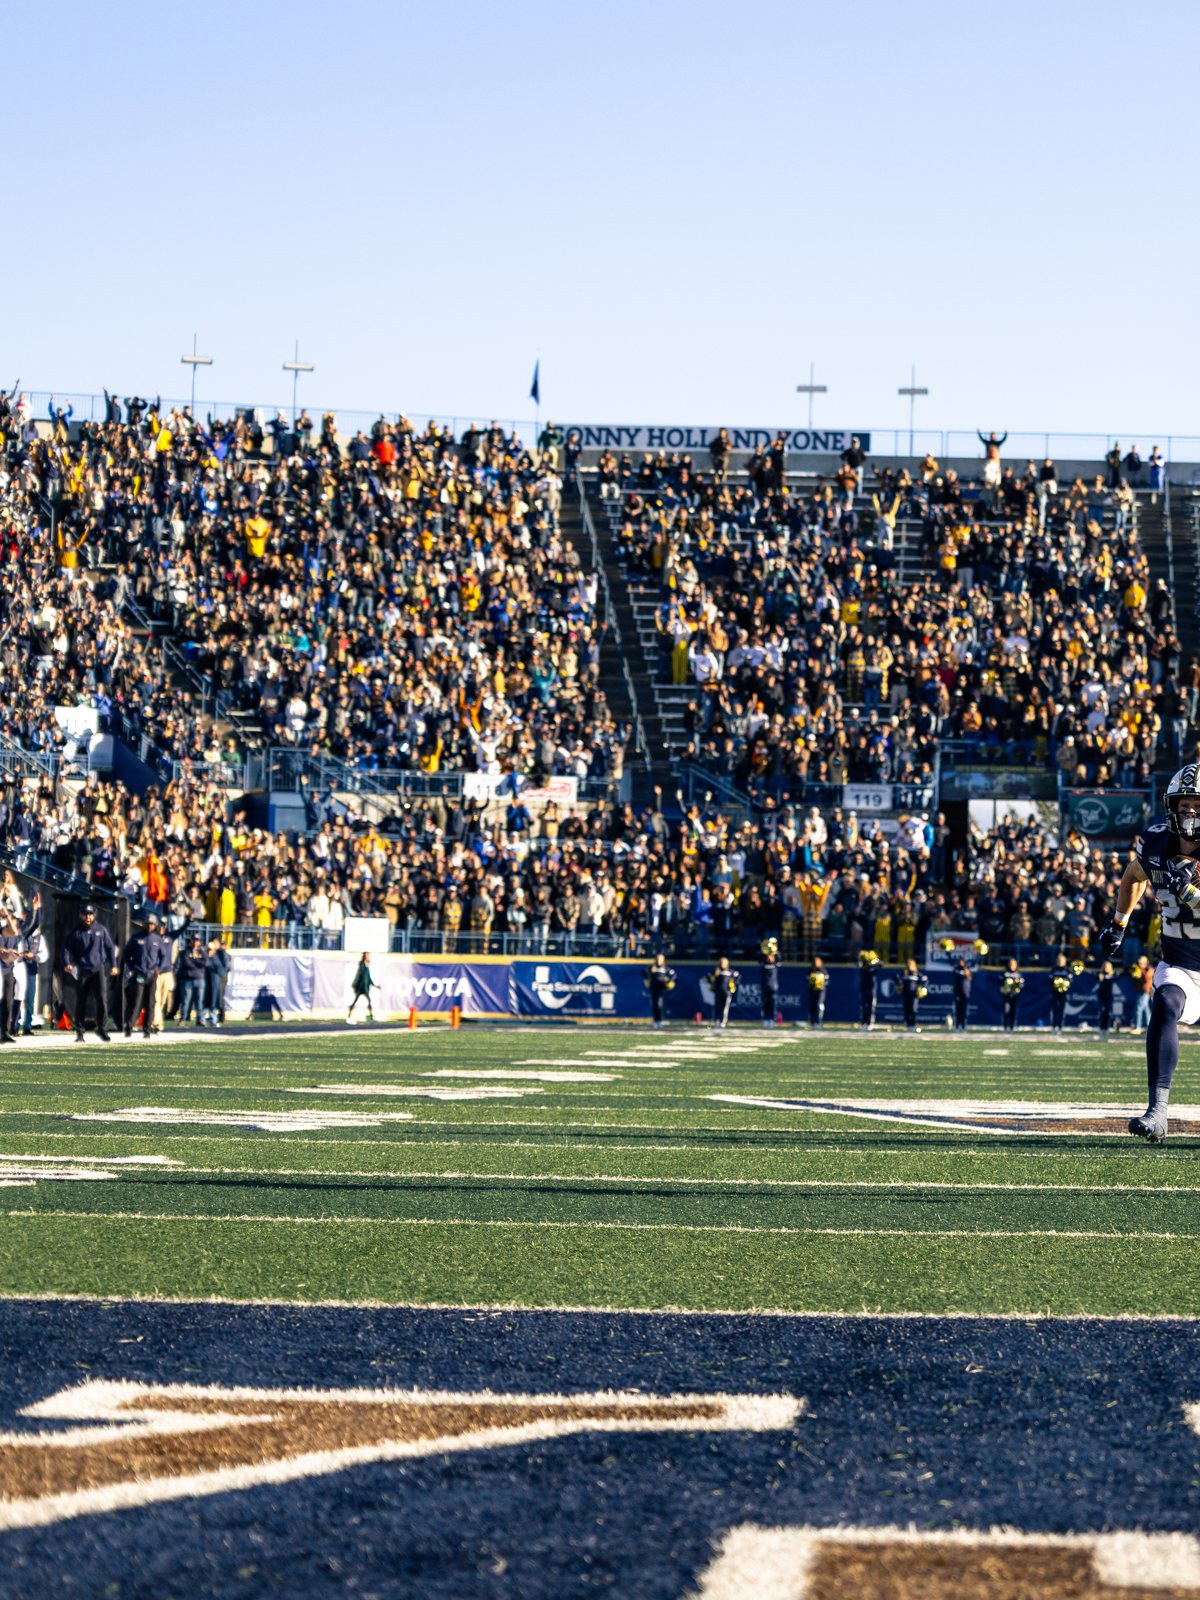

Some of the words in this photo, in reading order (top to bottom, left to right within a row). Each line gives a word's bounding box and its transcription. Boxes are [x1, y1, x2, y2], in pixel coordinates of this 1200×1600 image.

[647, 427, 771, 449] HOLLND
[854, 794, 882, 807] 119
[384, 976, 473, 998] TOYOTA
